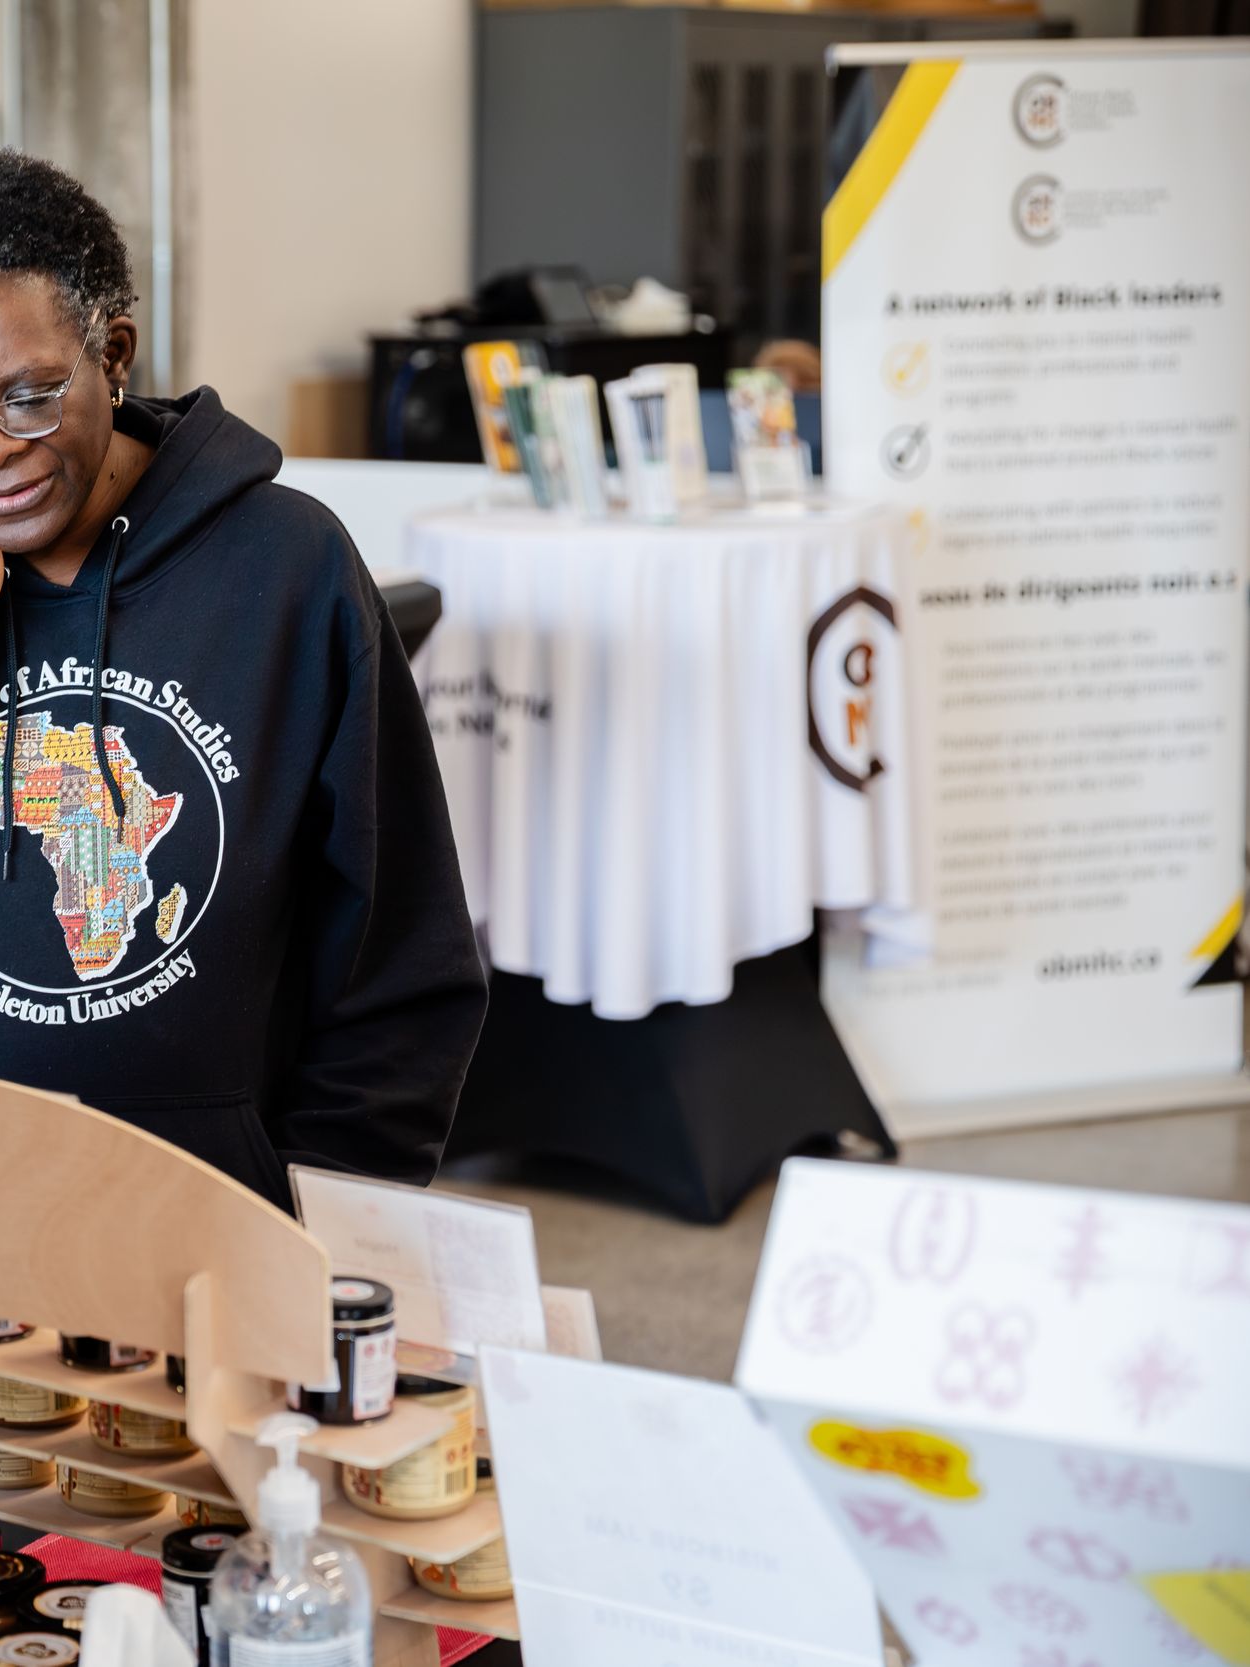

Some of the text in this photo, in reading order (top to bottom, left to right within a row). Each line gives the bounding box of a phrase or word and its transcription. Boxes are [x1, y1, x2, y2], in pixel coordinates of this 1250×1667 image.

[907, 289, 1016, 314] network
[1022, 285, 1047, 311] of
[1052, 281, 1121, 309] Black
[1129, 280, 1225, 307] leaders
[0, 666, 33, 703] of
[36, 657, 154, 702] African
[154, 680, 240, 783] Studies
[67, 948, 197, 1023] University
